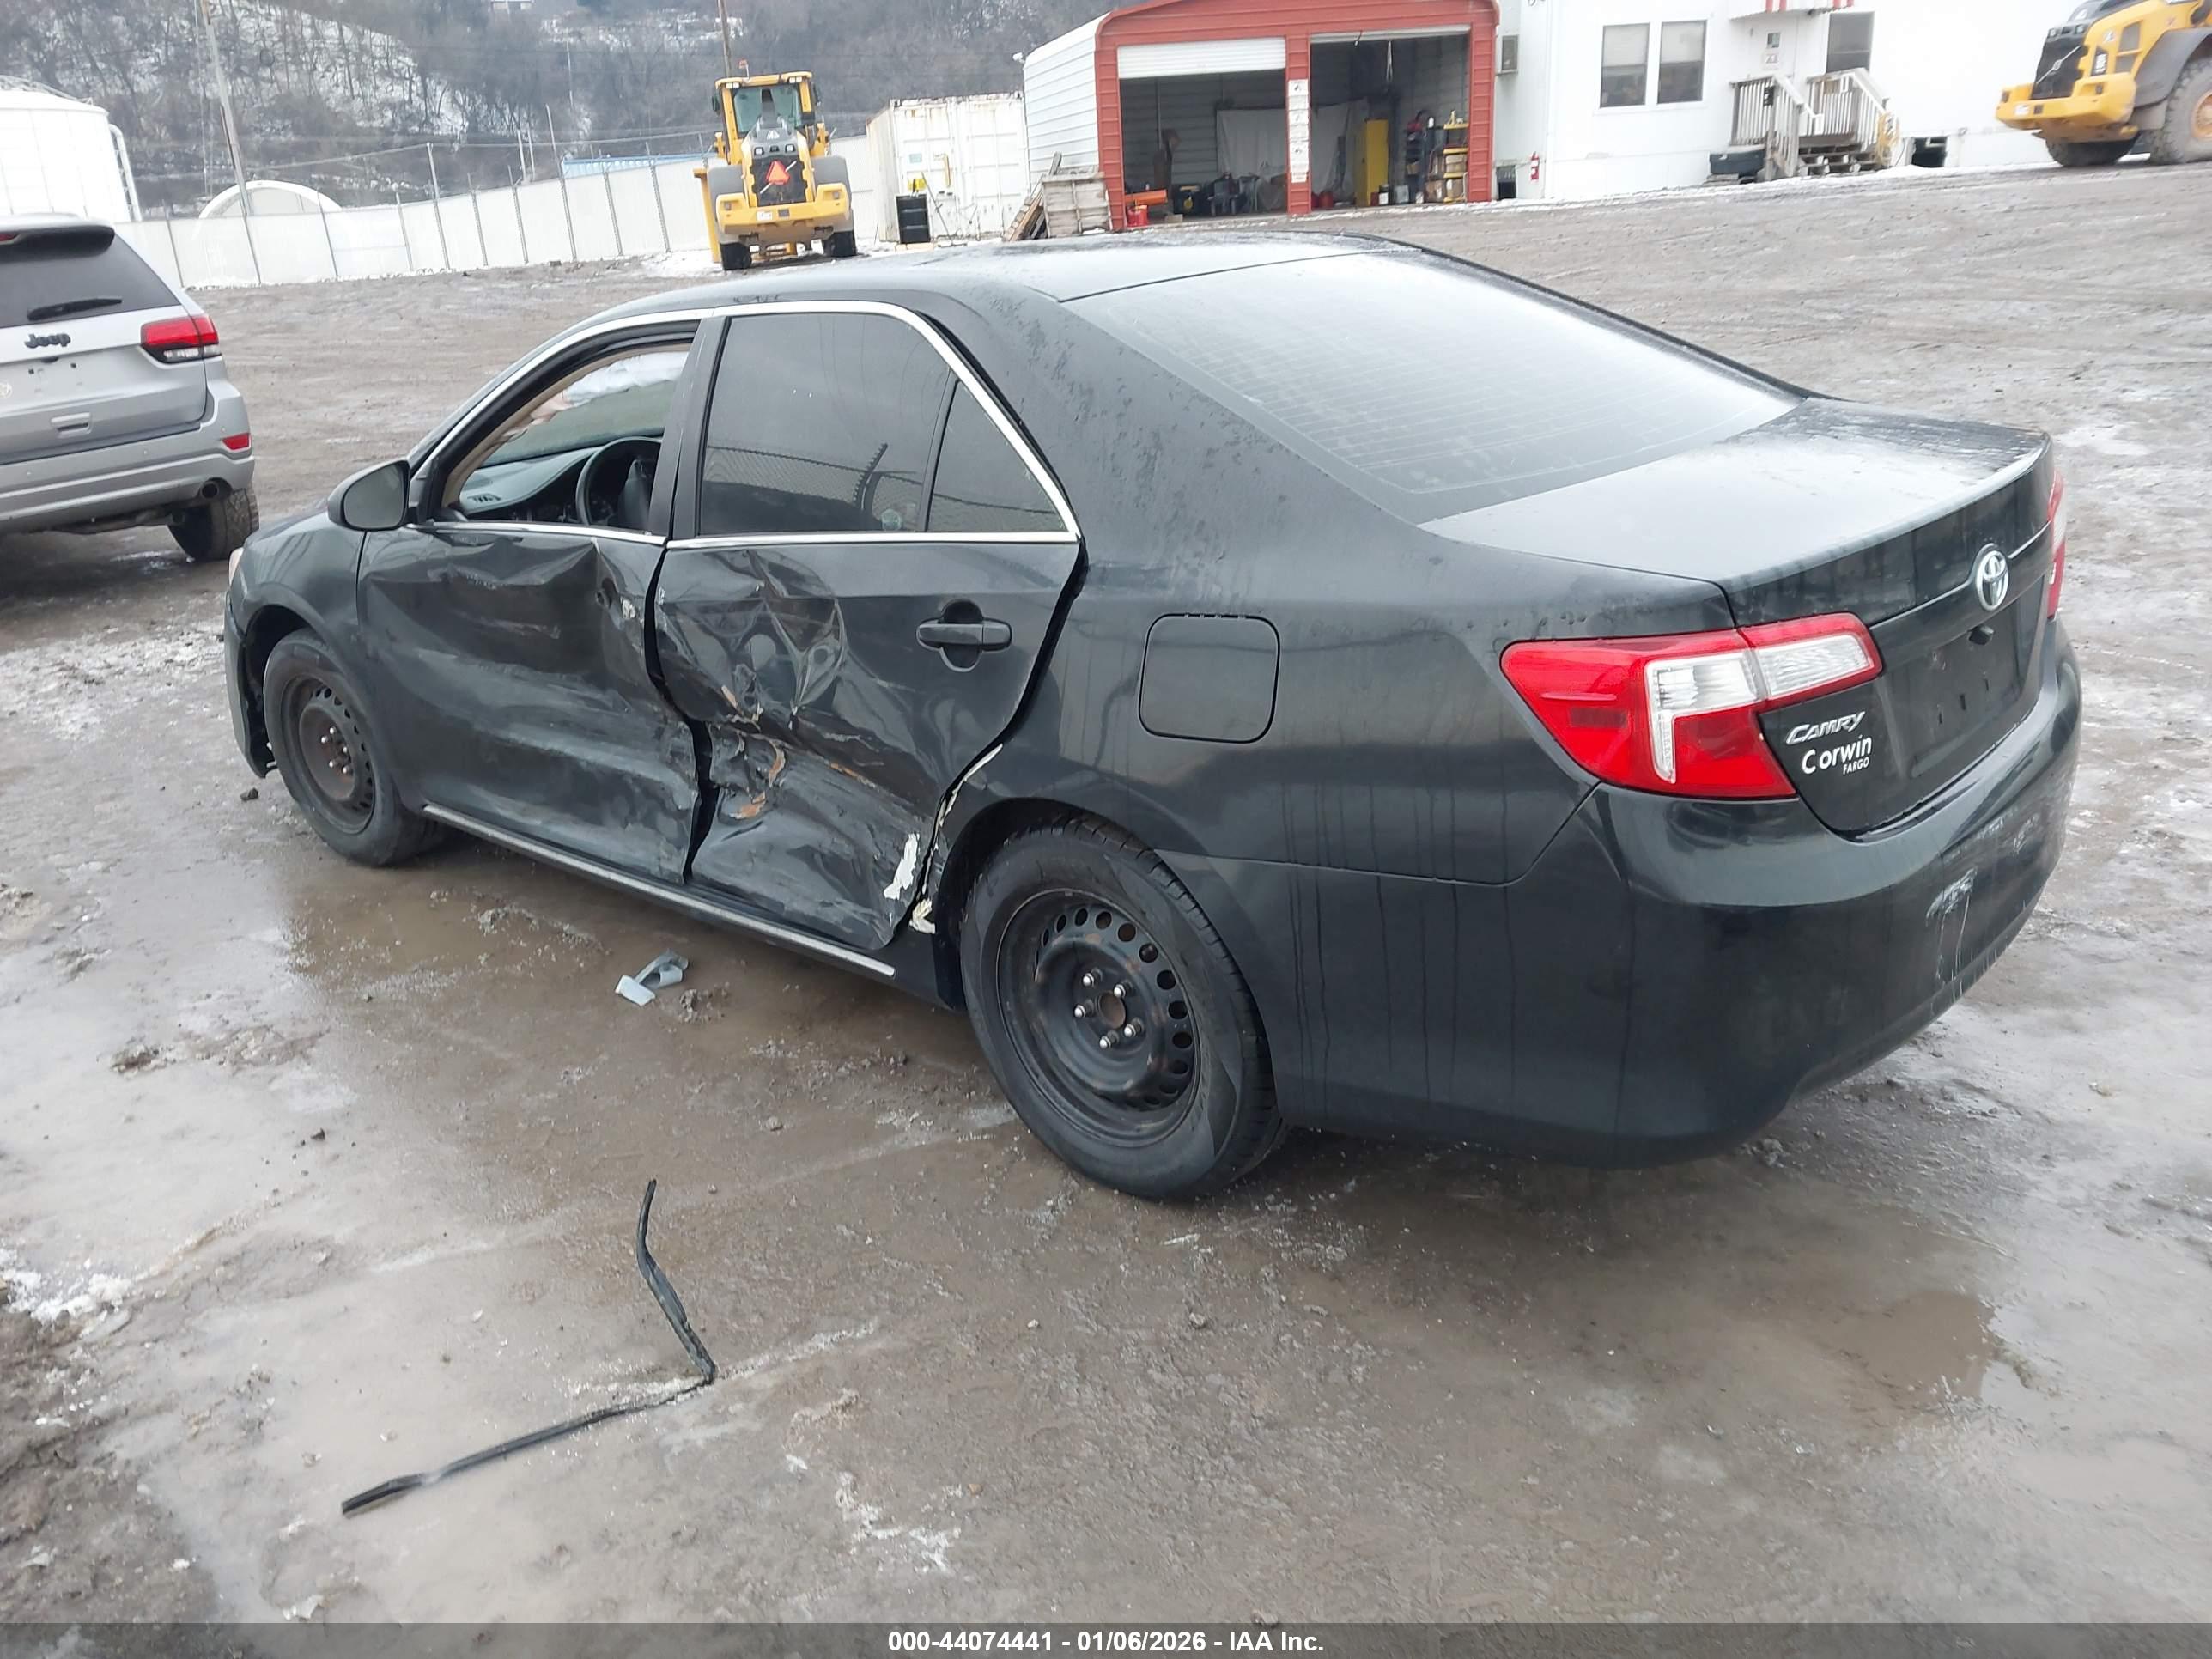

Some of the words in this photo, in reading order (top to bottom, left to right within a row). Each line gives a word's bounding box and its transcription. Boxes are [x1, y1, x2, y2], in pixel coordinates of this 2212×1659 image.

[24, 333, 71, 349] Jeep
[1785, 711, 1866, 745] CAMRY
[1802, 734, 1872, 775] Corwin
[1842, 757, 1869, 775] FARGO
